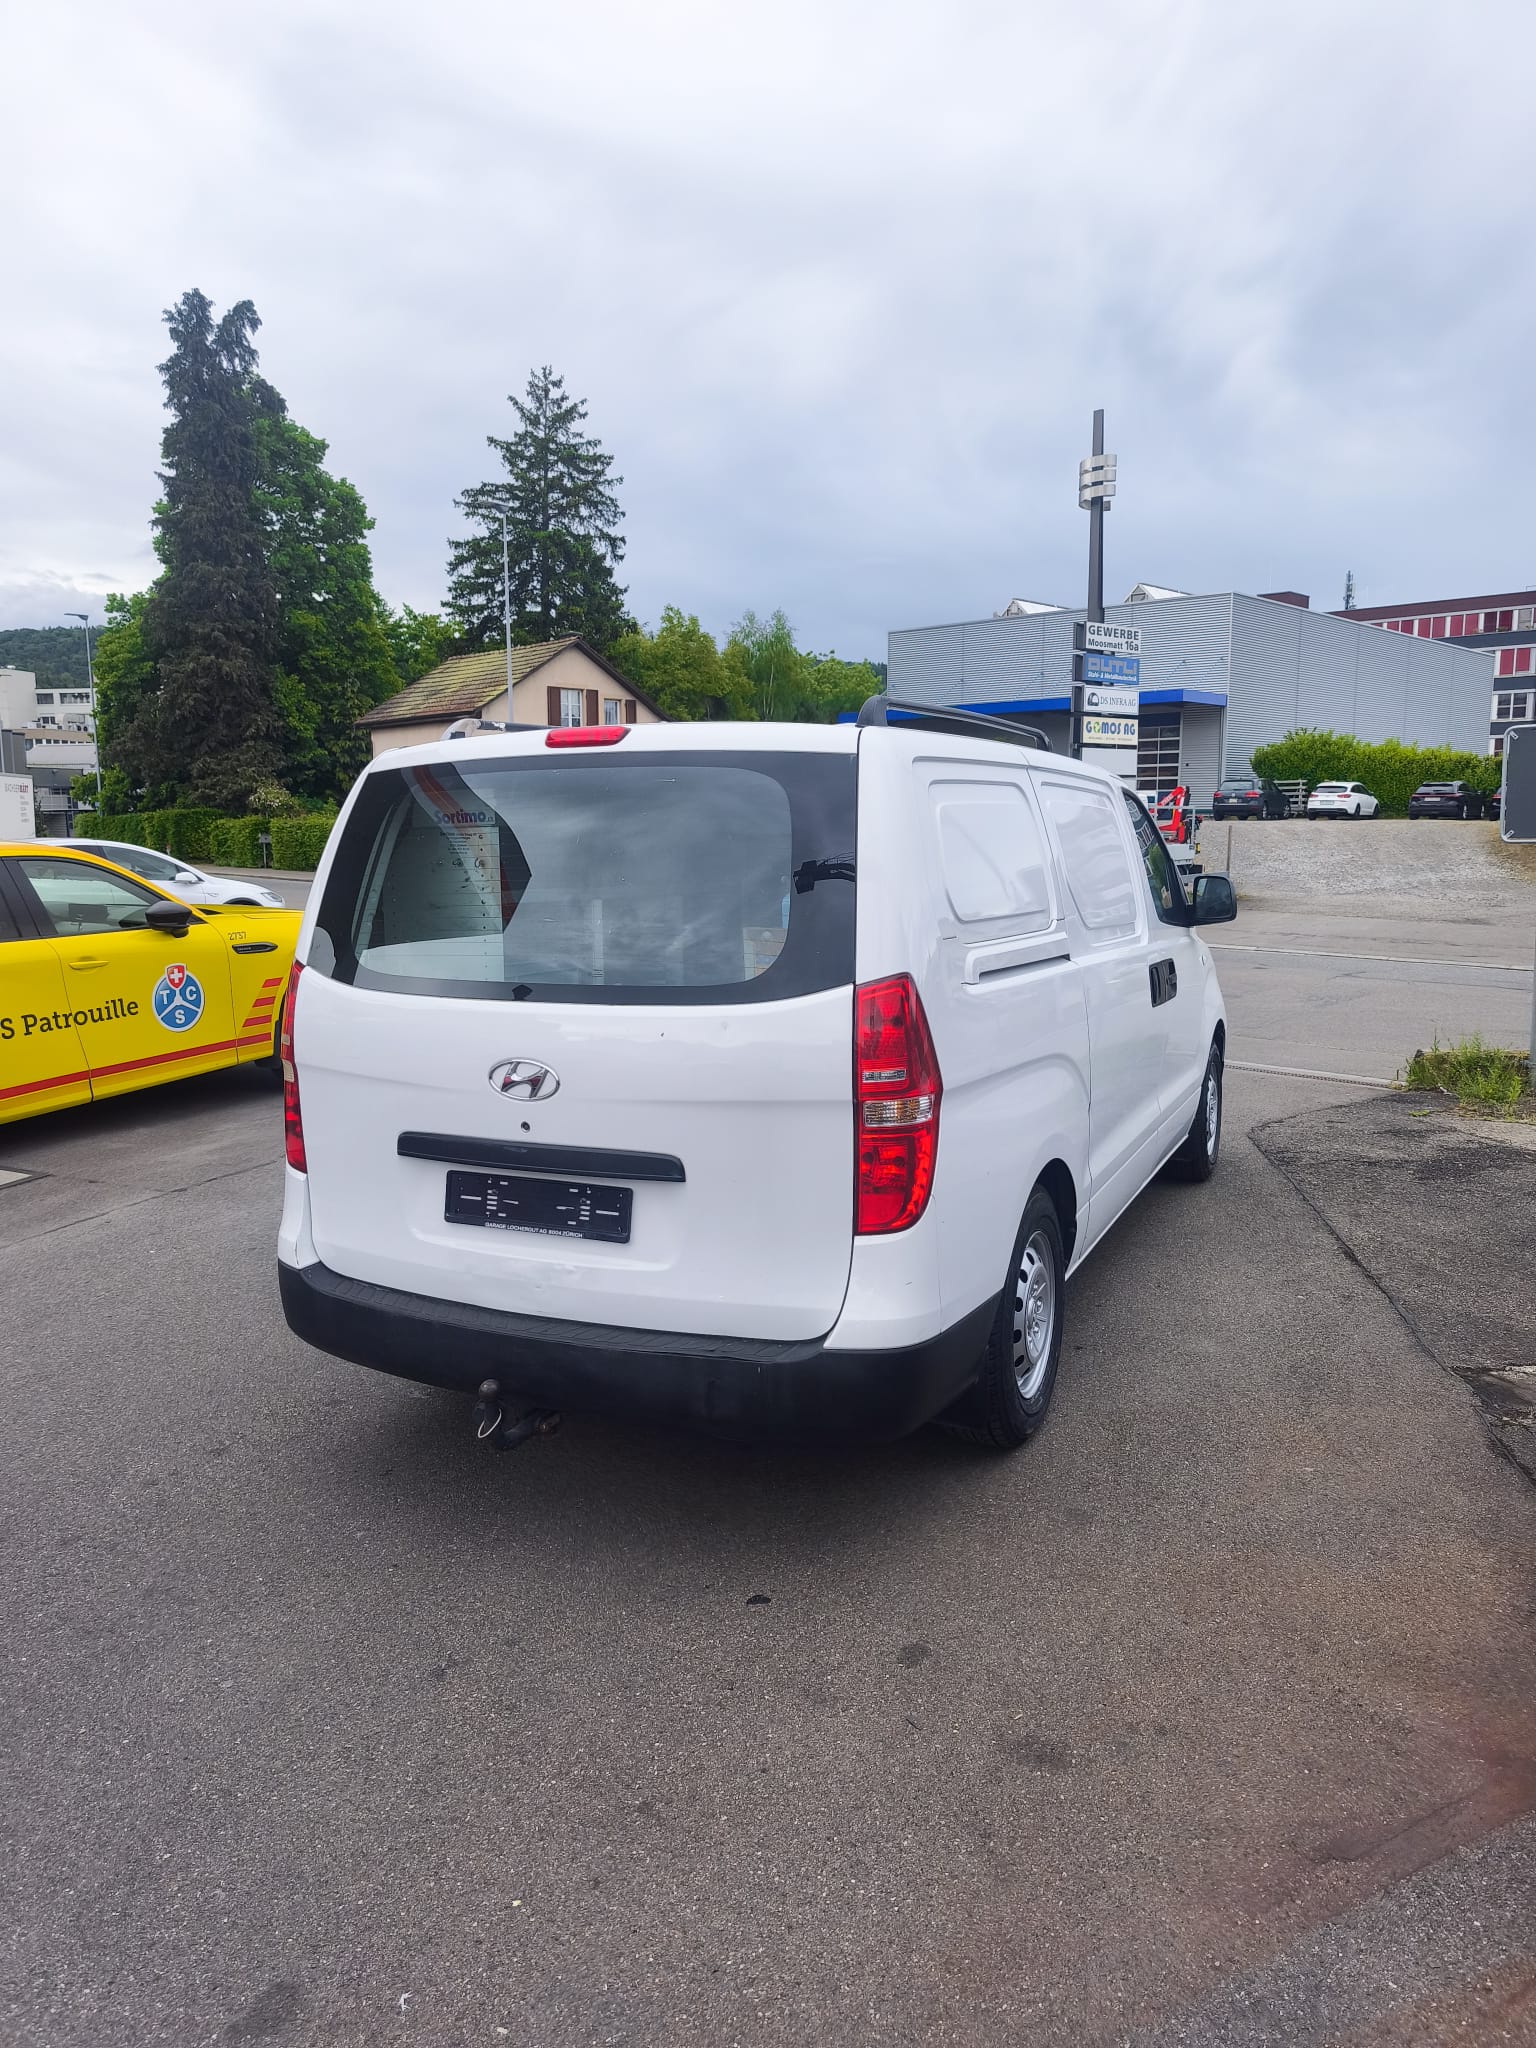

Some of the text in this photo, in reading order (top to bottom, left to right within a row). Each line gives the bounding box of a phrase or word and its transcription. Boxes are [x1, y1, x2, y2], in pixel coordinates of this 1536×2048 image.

[1088, 625, 1140, 640] GEWERBE
[1088, 638, 1139, 651] Moosmatt 16a
[1100, 696, 1137, 707] DS INFRA AG
[1123, 723, 1136, 736] AG
[434, 808, 487, 824] Sortimo
[21, 998, 139, 1036] Patrouille
[485, 1221, 506, 1229] GARAGE
[562, 1230, 583, 1238] ZÜRICH
